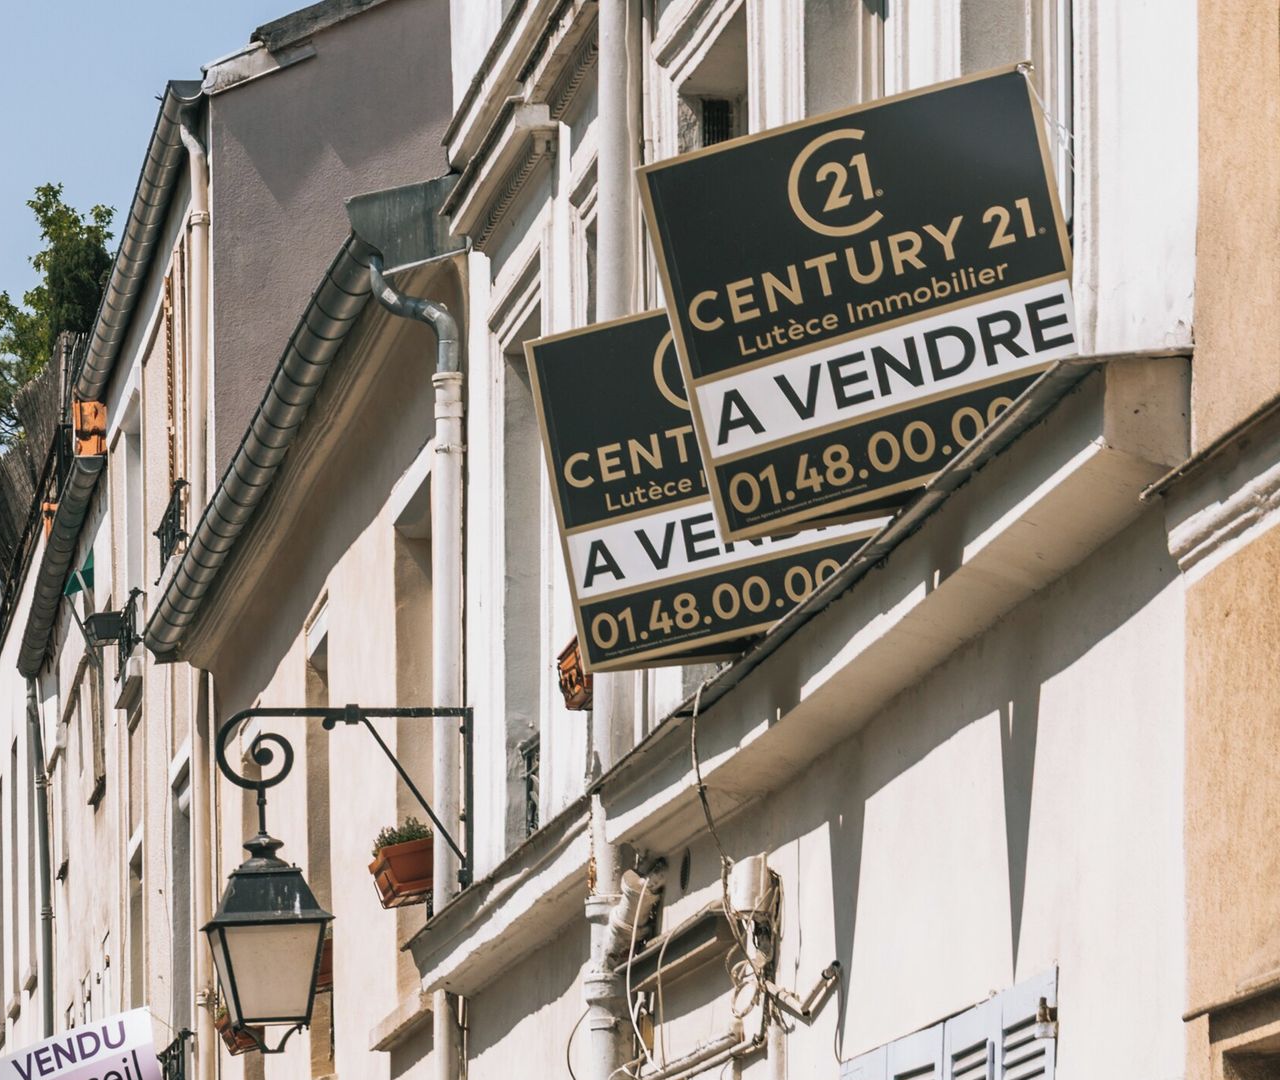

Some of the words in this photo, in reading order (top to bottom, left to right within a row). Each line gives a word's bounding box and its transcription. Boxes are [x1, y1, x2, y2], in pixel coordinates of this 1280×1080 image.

[689, 215, 963, 332] CENTURY
[981, 197, 1037, 250] 21
[738, 311, 839, 356] Lutèce
[847, 262, 1009, 324] Immobilier
[717, 388, 767, 446] A
[773, 293, 1076, 421] VENDRE
[564, 425, 694, 488] CENT
[604, 478, 693, 511] Lutèce
[582, 538, 626, 588] A
